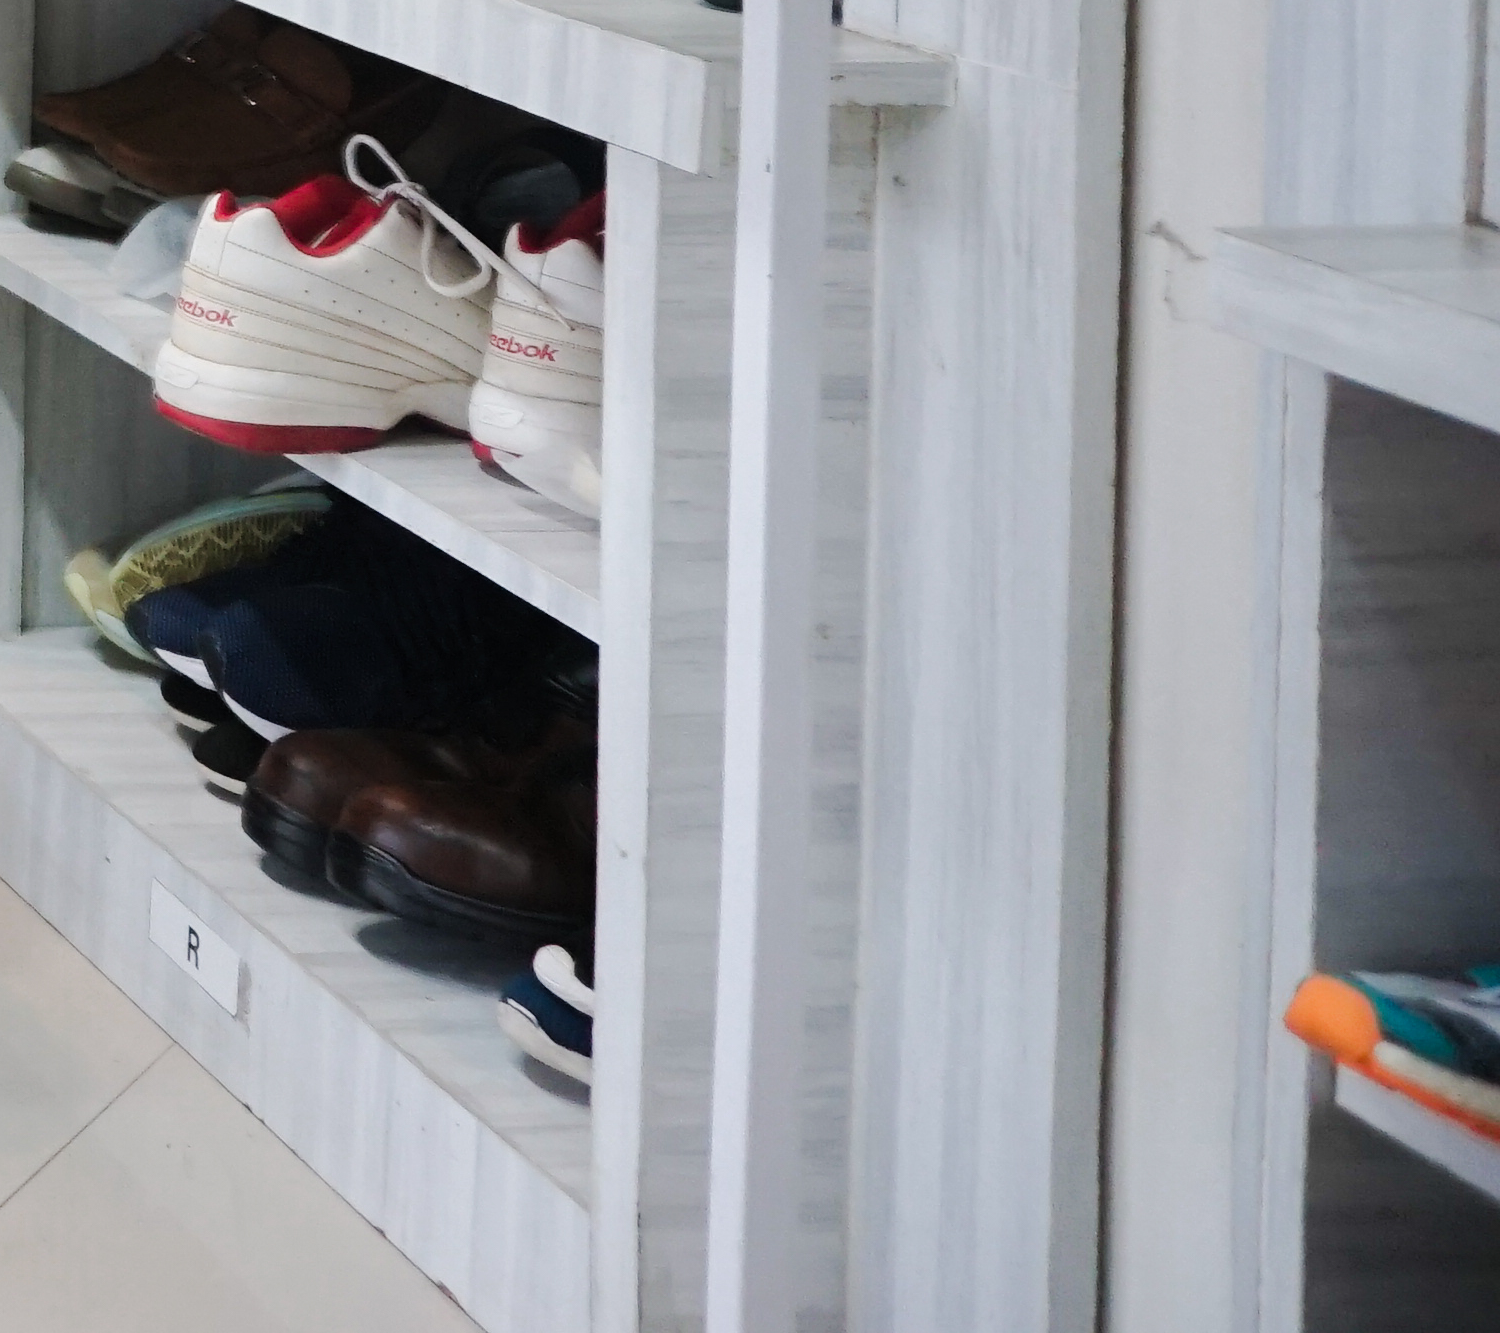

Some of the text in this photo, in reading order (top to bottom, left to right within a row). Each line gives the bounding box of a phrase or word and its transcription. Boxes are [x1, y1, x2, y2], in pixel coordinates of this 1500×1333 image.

[177, 295, 239, 329] eebok
[488, 333, 561, 363] eebok
[187, 925, 200, 971] R
